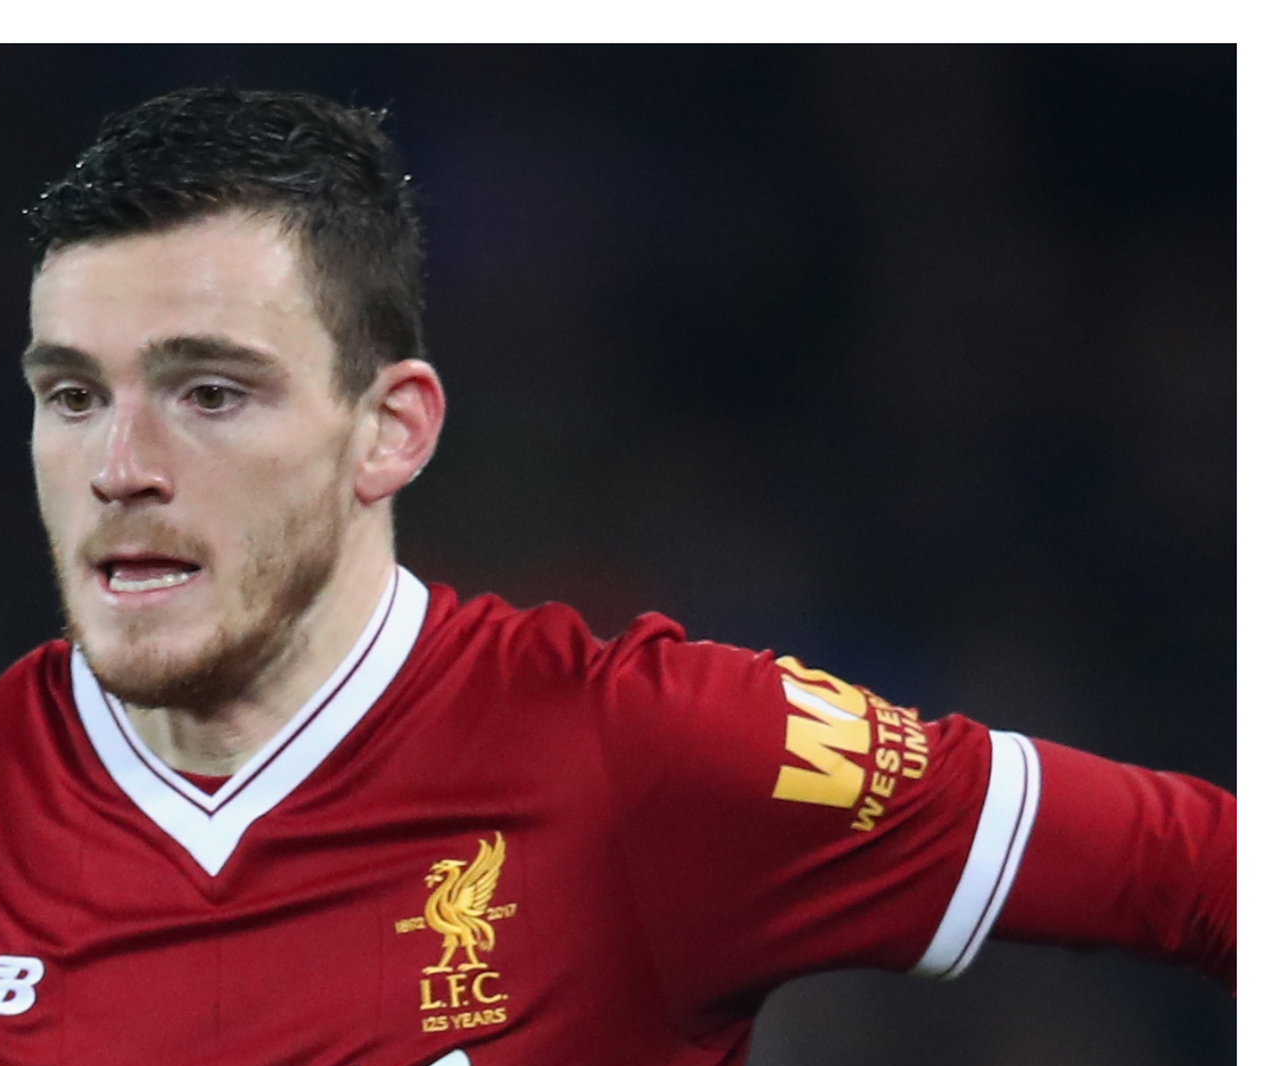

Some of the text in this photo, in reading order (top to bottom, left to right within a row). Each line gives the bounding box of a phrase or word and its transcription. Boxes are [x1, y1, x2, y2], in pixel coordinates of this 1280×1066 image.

[420, 972, 509, 1010] L.F.C.
[422, 1007, 507, 1032] 125 YEARS
